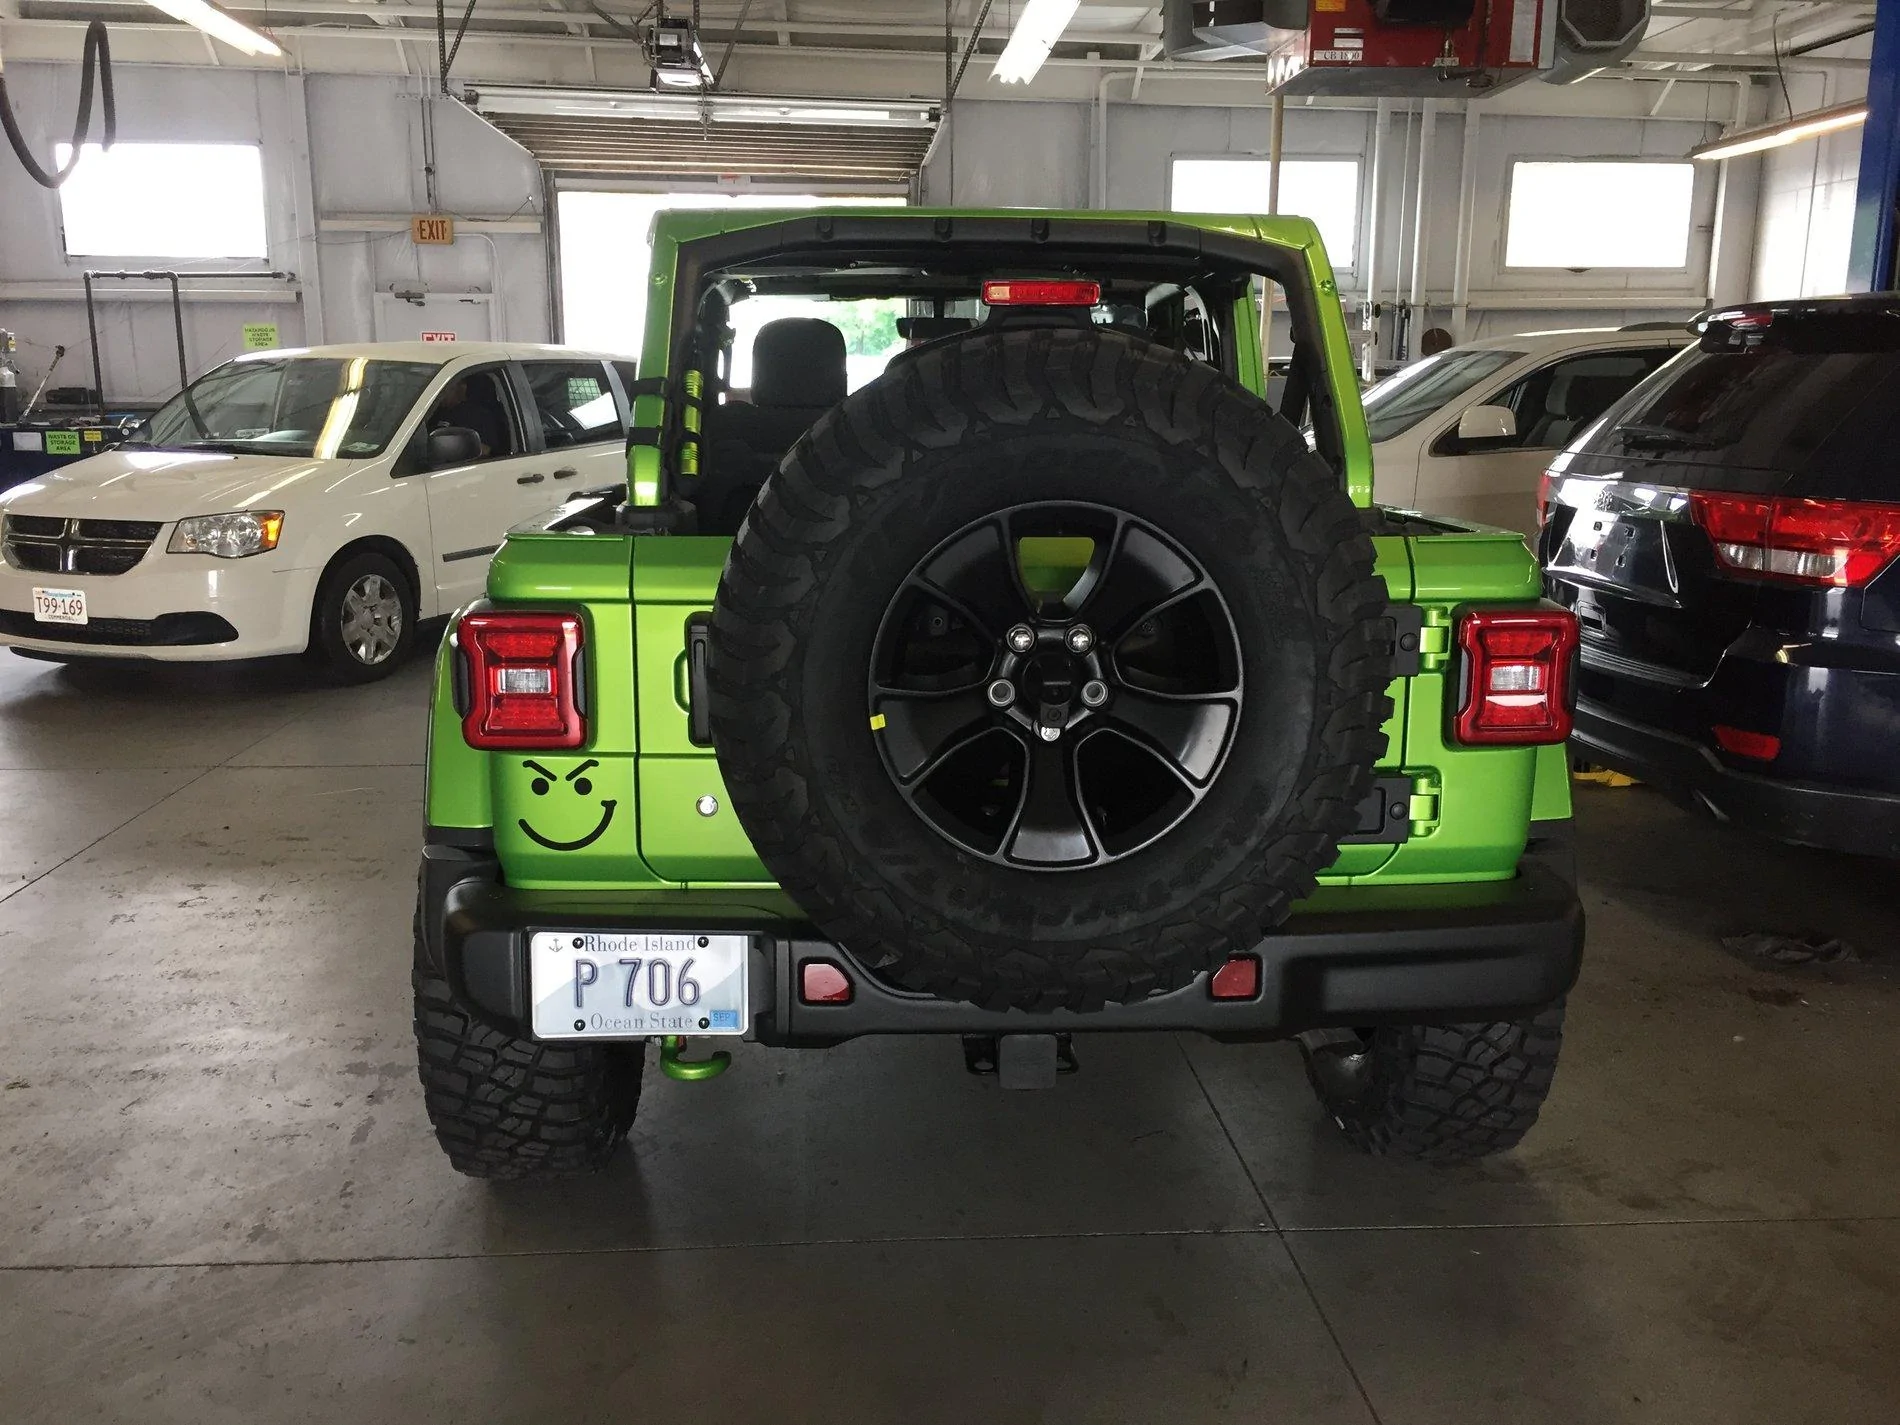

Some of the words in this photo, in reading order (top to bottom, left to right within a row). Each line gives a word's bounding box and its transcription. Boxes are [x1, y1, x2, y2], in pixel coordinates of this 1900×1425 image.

[419, 220, 446, 240] EXIT
[584, 935, 638, 952] Rhode
[645, 935, 697, 952] Island
[575, 958, 599, 1008] P
[618, 957, 701, 1008] 706
[590, 1012, 641, 1030] Ocean
[649, 1012, 693, 1030] State
[713, 1012, 731, 1022] SEP
